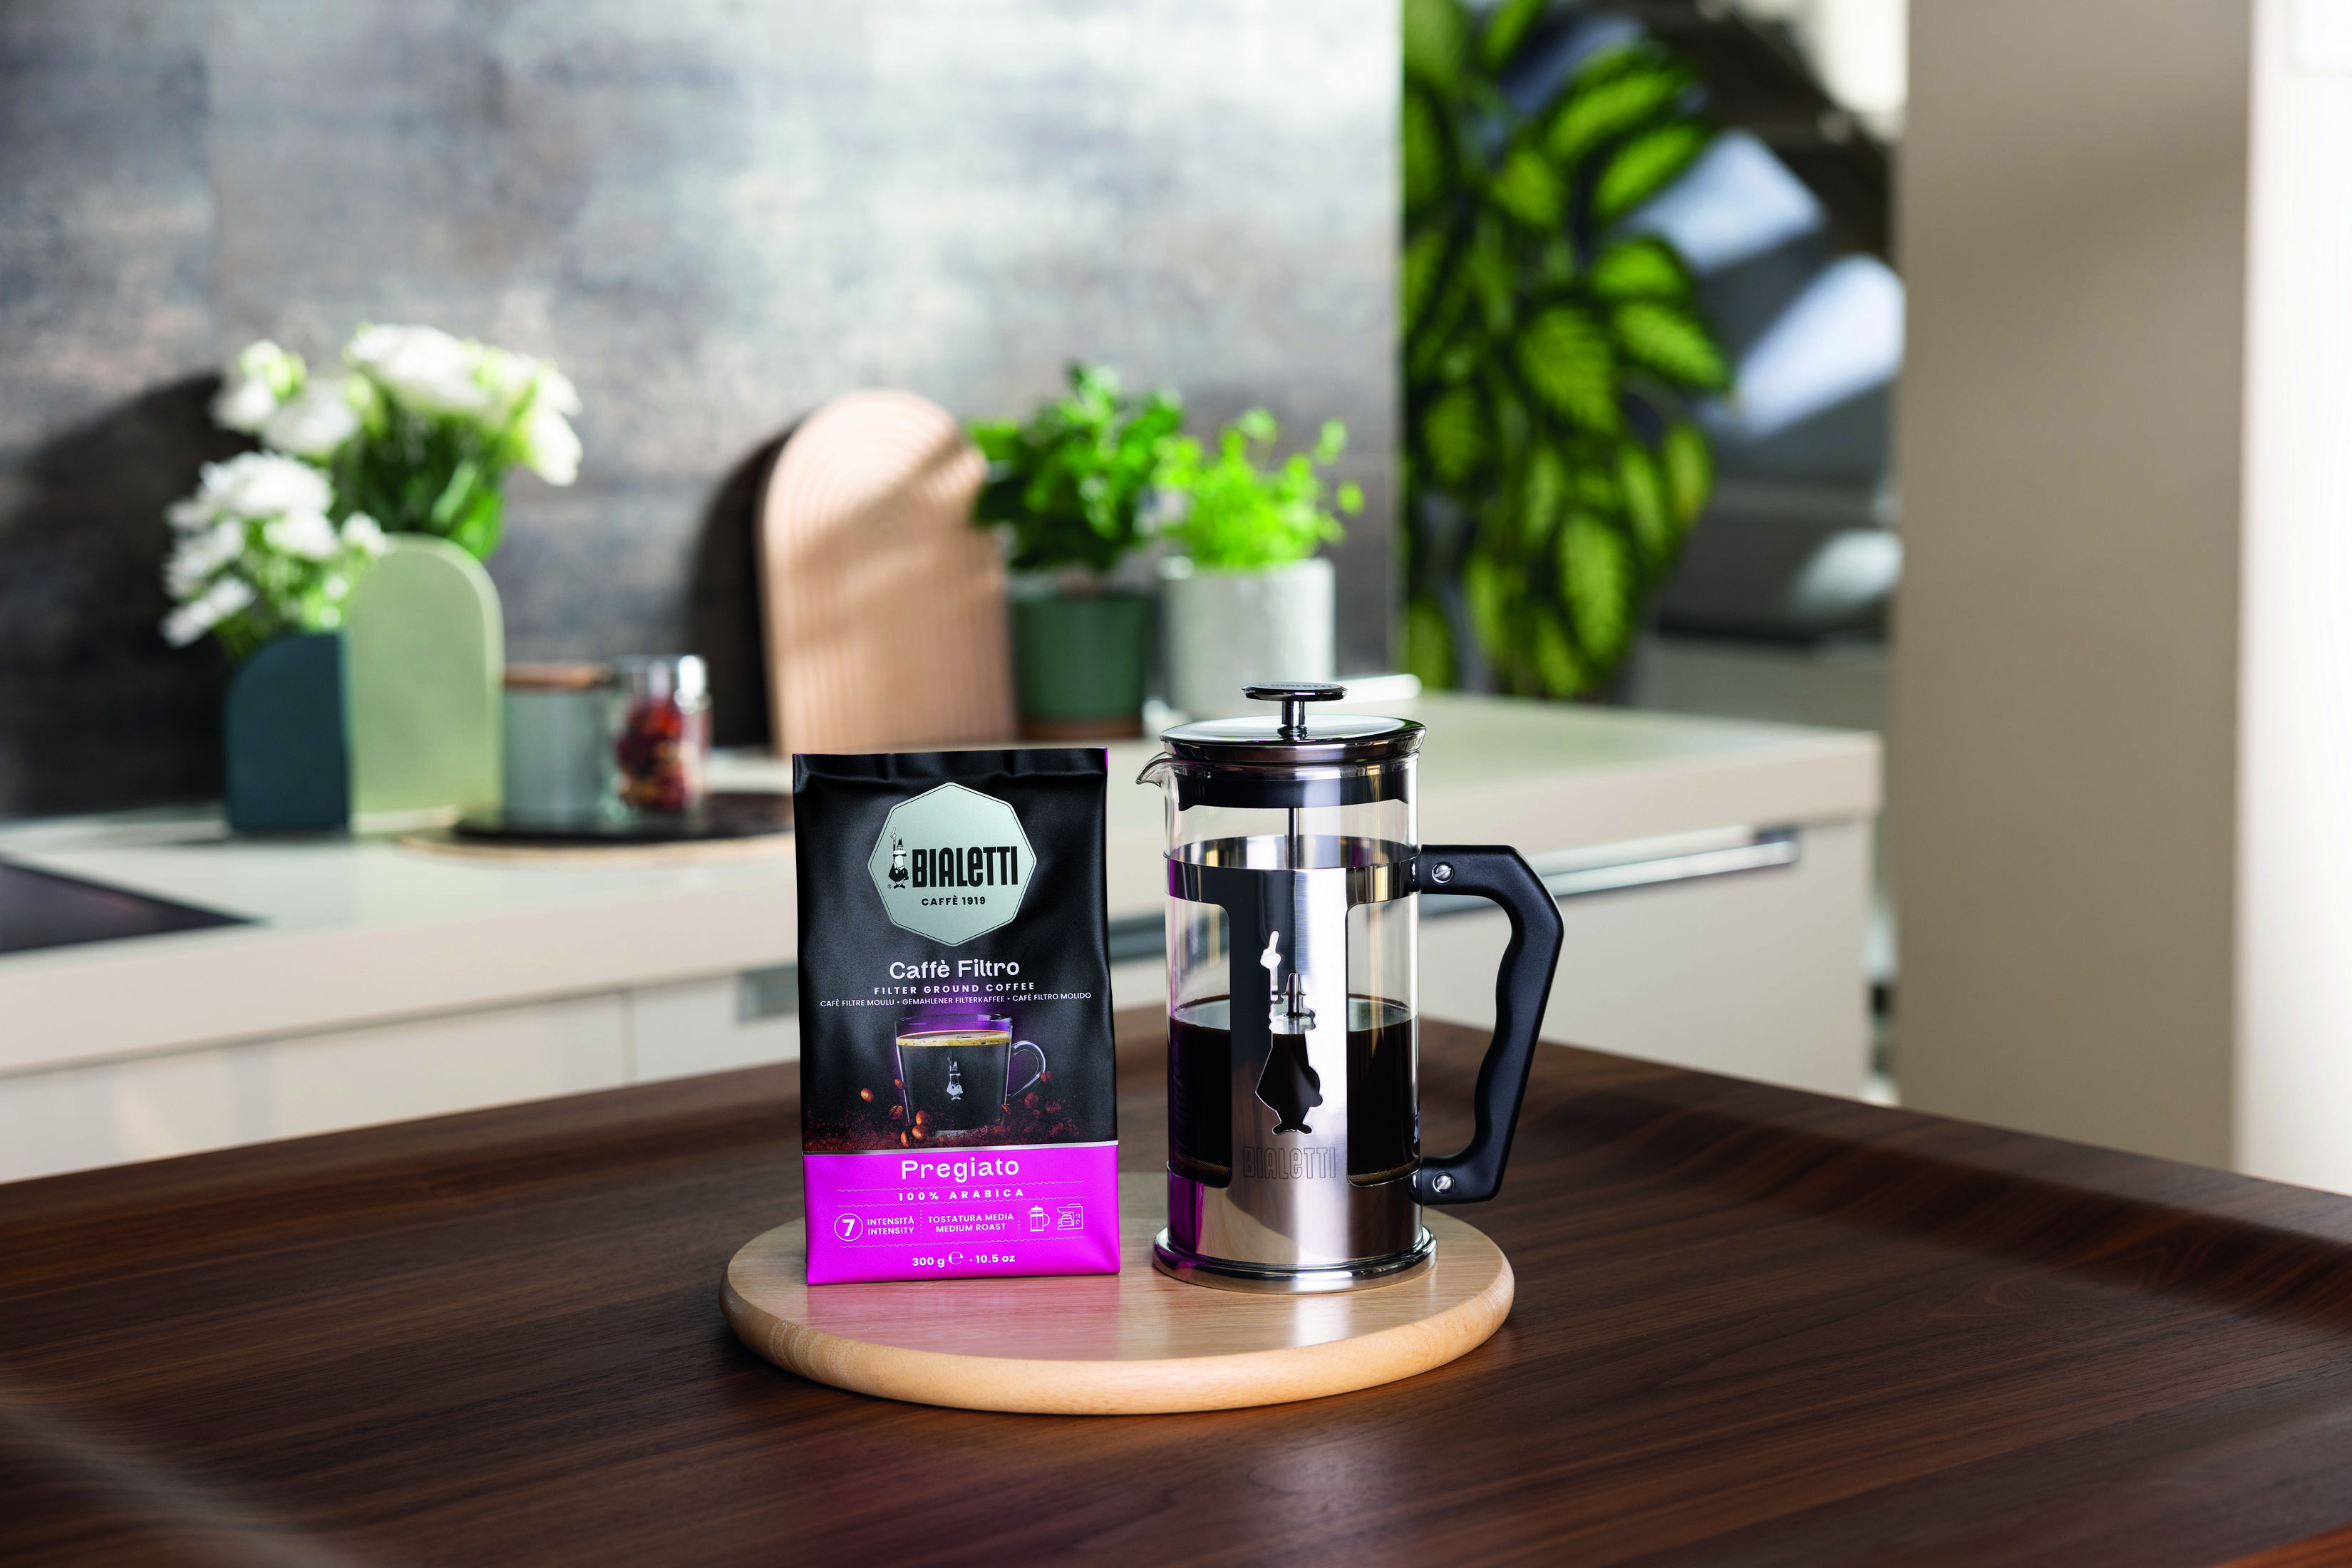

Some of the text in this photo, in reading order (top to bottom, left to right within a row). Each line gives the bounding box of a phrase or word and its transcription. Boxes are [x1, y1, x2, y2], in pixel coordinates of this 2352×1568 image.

[922, 895, 986, 906] CAFFÈ 1919
[889, 959, 1020, 979] Caffè Filtro
[924, 985, 979, 994] GROUND
[986, 982, 1035, 992] COFFEE
[902, 1156, 1019, 1183] Pregiato
[898, 1188, 1023, 1201] 100% ARABICA
[867, 1215, 914, 1225] INTENSITÀ
[928, 1214, 982, 1223] TOSTATURA
[842, 1218, 855, 1237] 7
[867, 1227, 914, 1235] INTENSITY
[936, 1224, 973, 1233] MEDIUM
[912, 1257, 934, 1267] 300
[937, 1258, 945, 1268] g
[975, 1254, 999, 1264] 10.5
